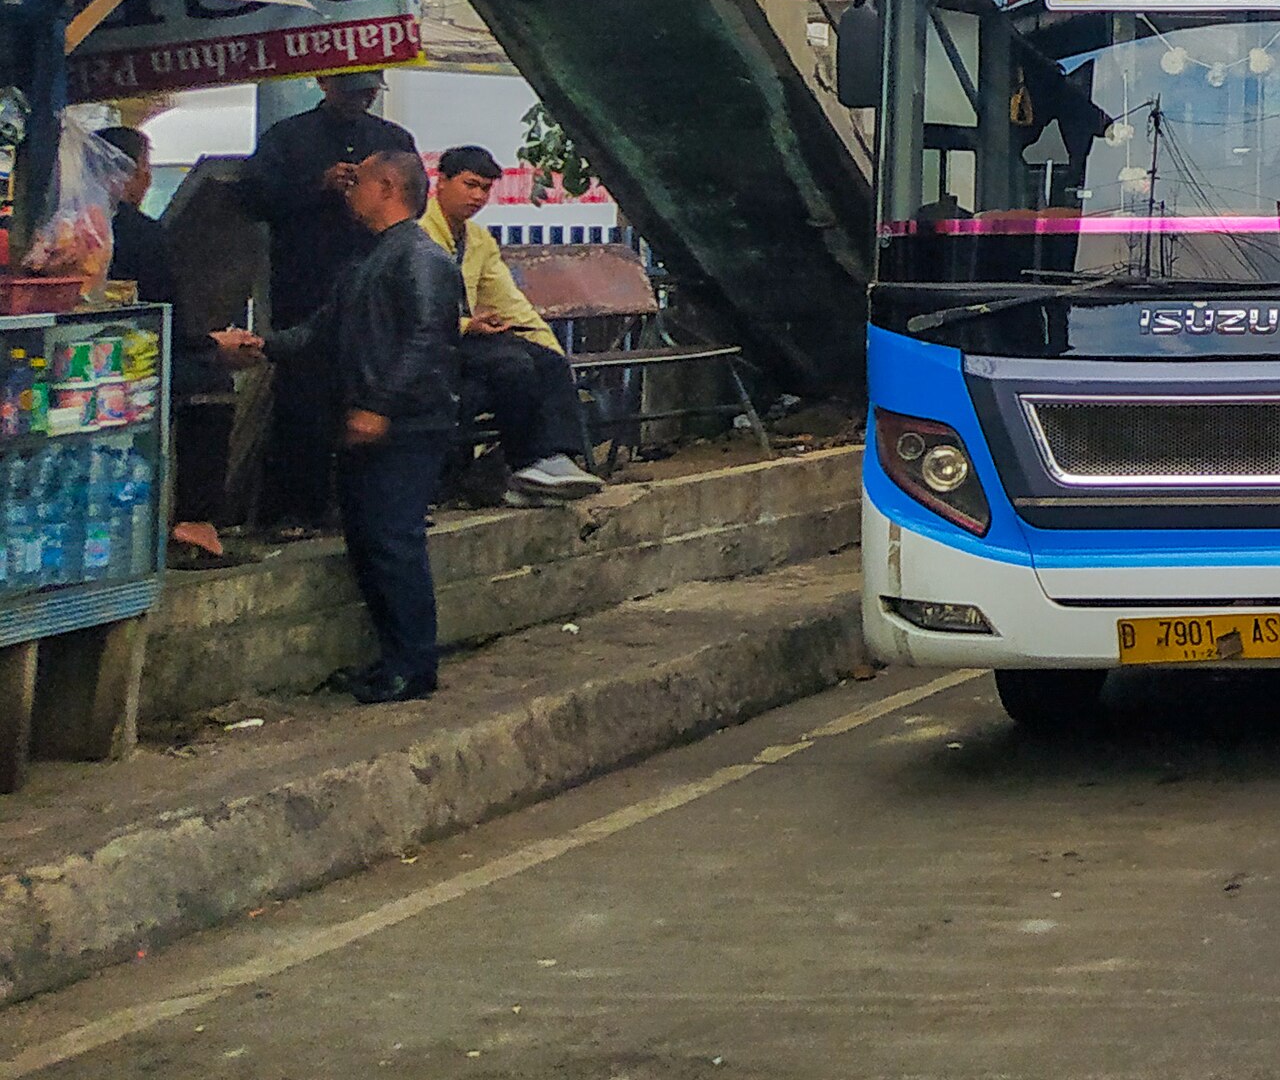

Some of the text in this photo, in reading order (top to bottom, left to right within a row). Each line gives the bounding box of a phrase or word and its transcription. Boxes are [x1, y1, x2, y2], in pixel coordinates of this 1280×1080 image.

[150, 37, 276, 77] Tahun
[1139, 308, 1280, 335] ISUZU
[1120, 617, 1280, 650] D 7901 AS
